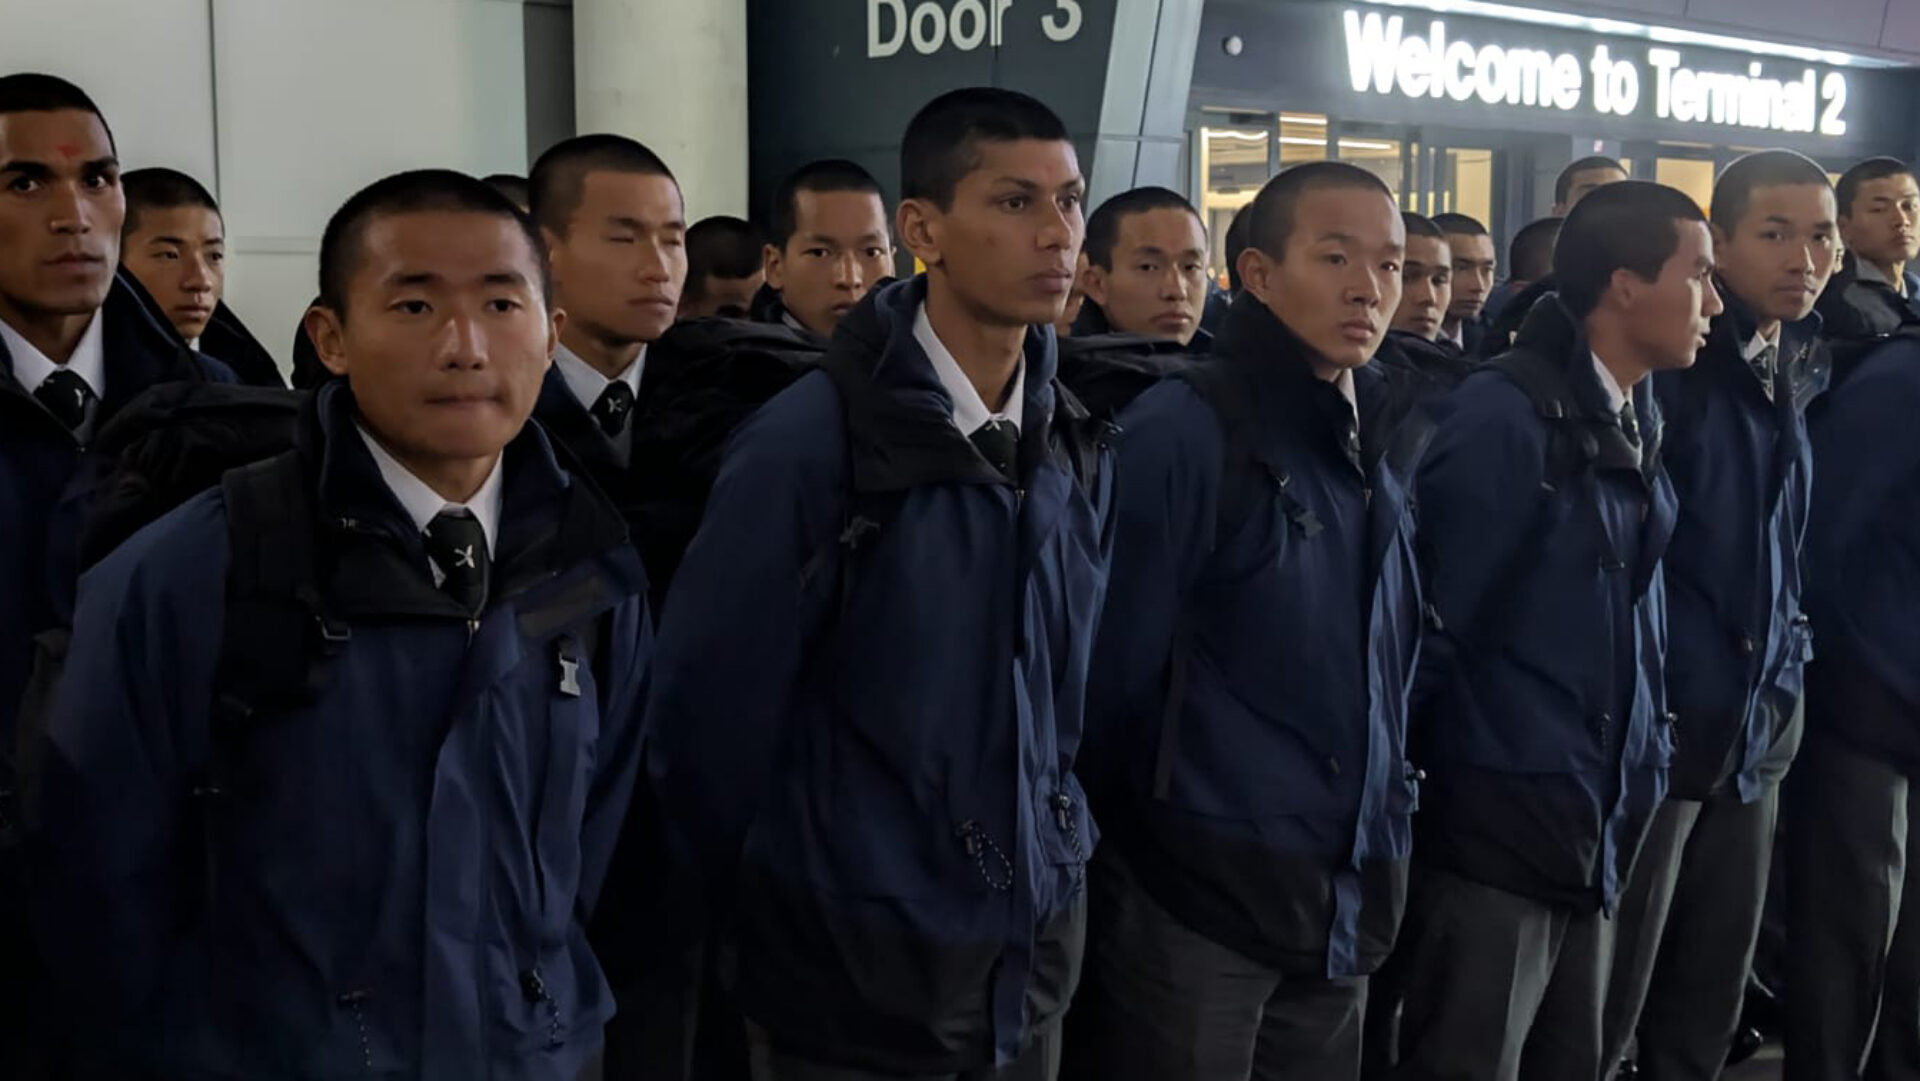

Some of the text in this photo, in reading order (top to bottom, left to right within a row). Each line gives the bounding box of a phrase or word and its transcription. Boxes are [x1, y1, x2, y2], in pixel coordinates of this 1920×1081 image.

[868, 0, 1083, 58] Door 3
[1344, 8, 1847, 136] Welcome to Terminal 2
